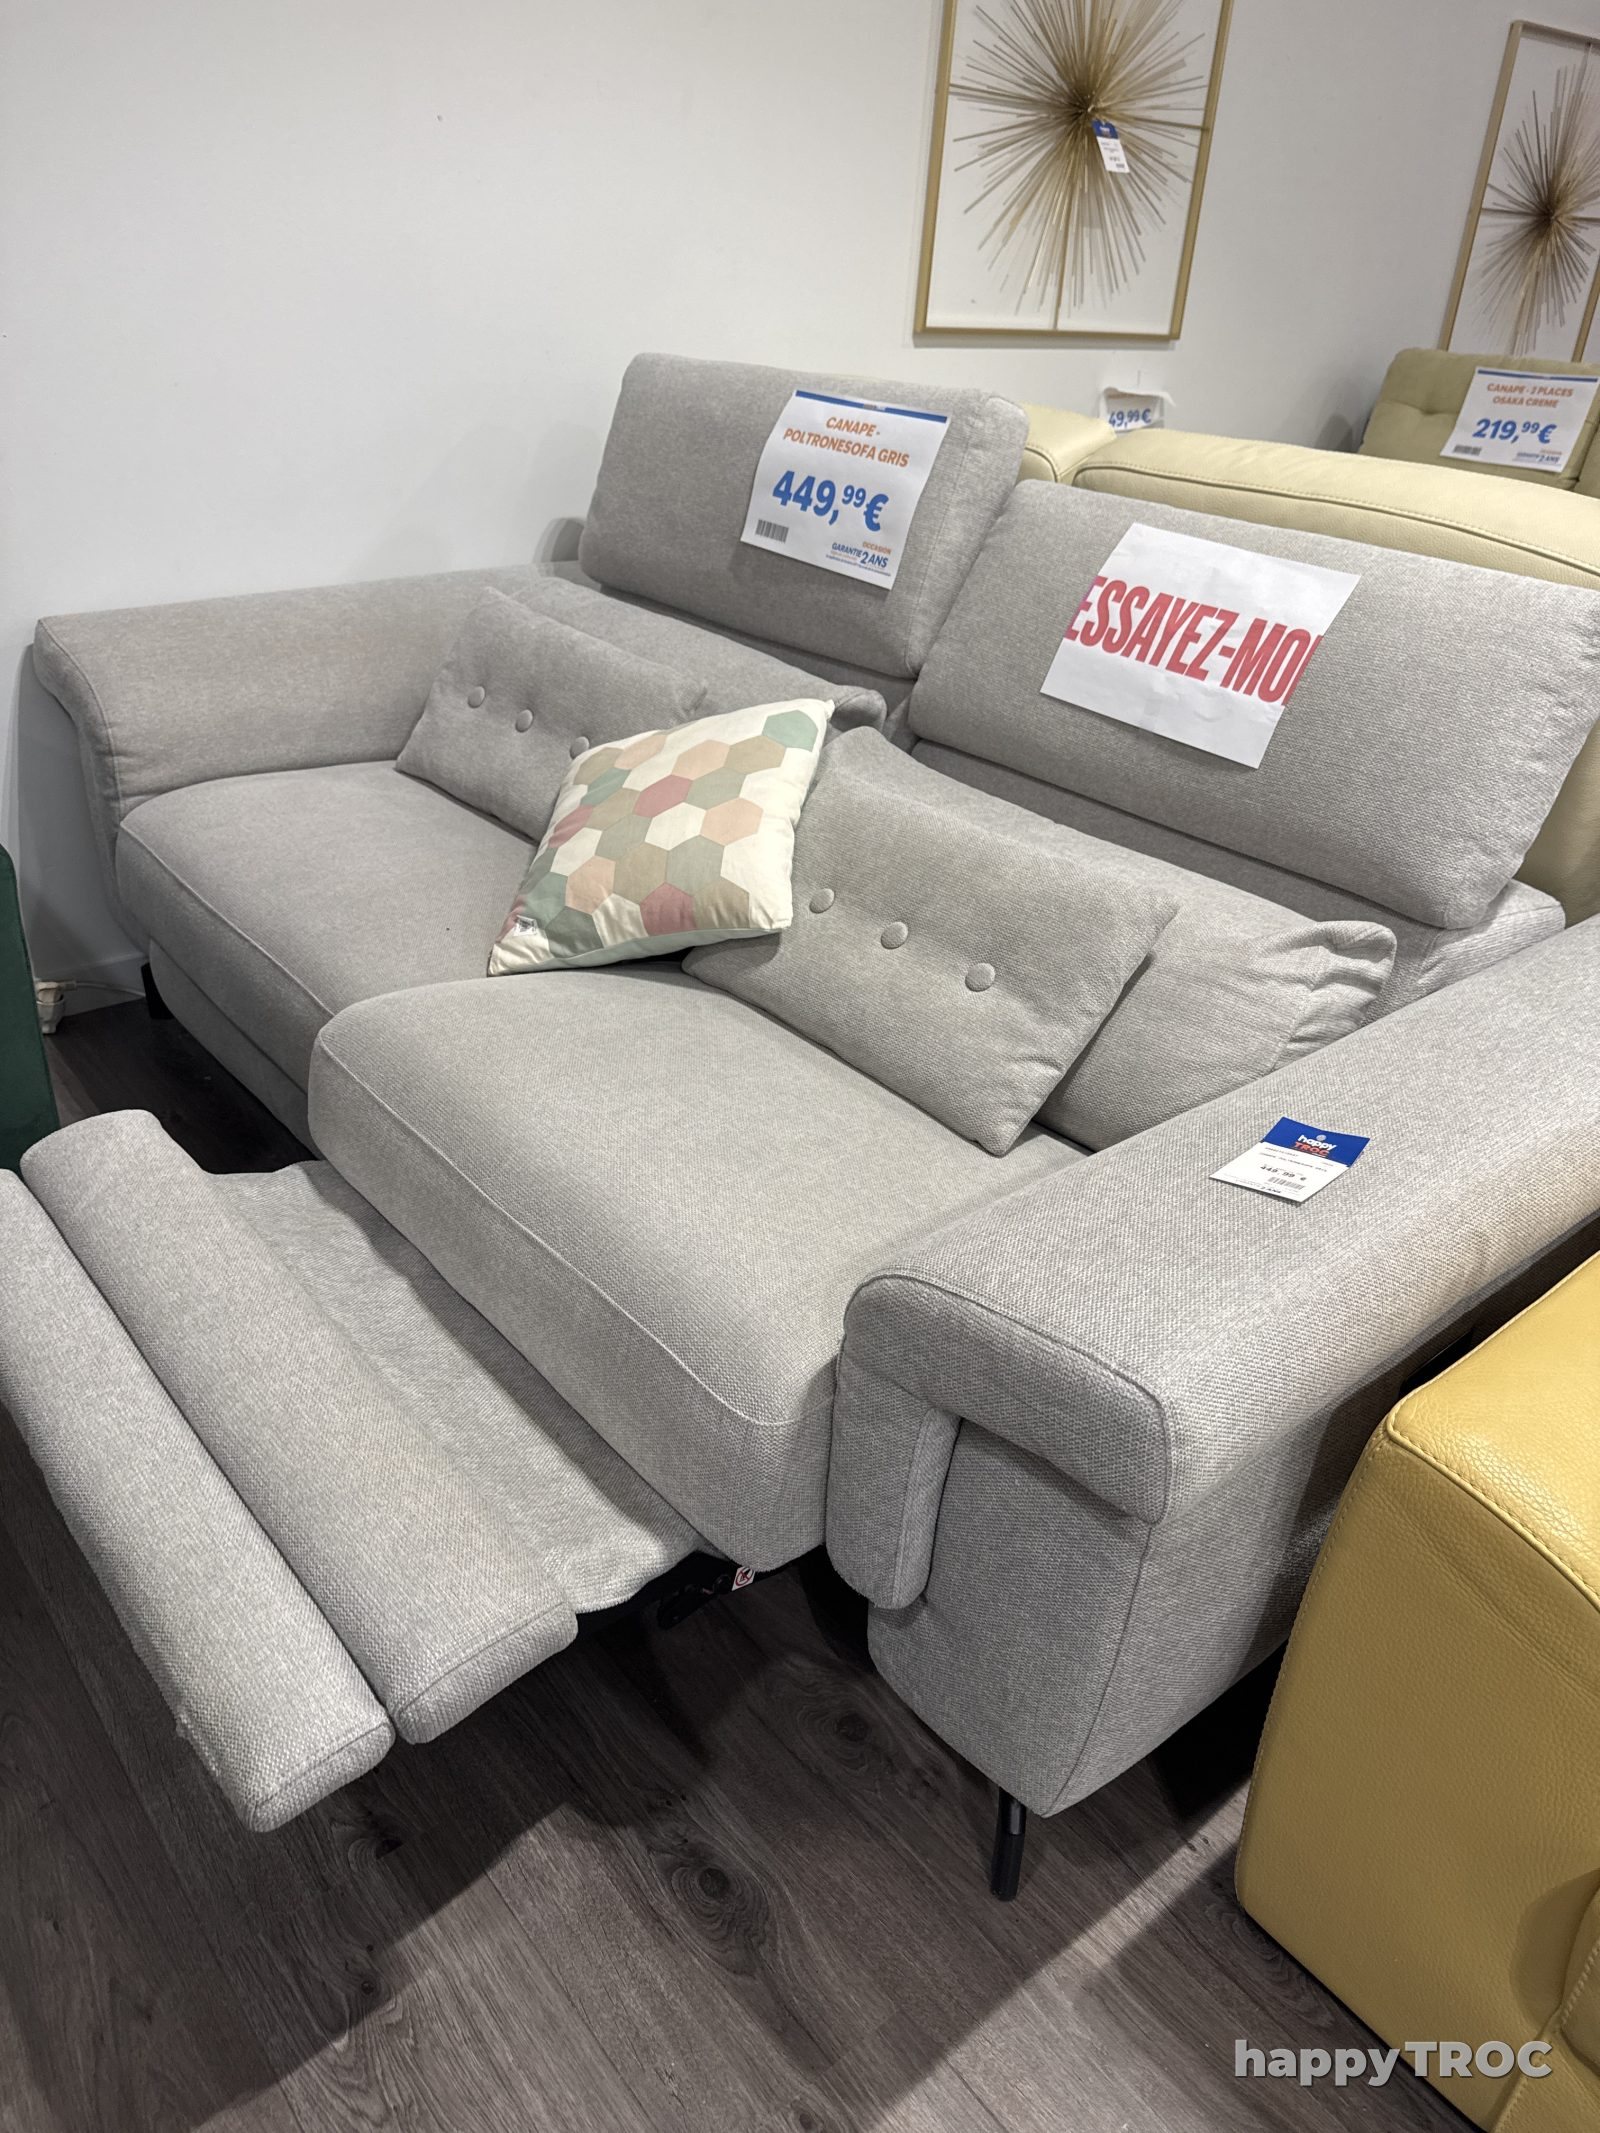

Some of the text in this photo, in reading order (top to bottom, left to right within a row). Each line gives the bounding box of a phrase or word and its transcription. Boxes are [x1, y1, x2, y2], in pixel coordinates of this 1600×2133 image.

[826, 416, 877, 437] CANAPE
[1472, 417, 1557, 444] 219,99€
[783, 428, 910, 468] POLTRONESOFA GRIS
[772, 470, 889, 532] 449,99€
[832, 542, 862, 558] GARANTIE
[860, 551, 869, 564] 2
[868, 553, 889, 568] ANS
[1295, 1142, 1330, 1156] TROC
[1297, 1134, 1337, 1150] happy
